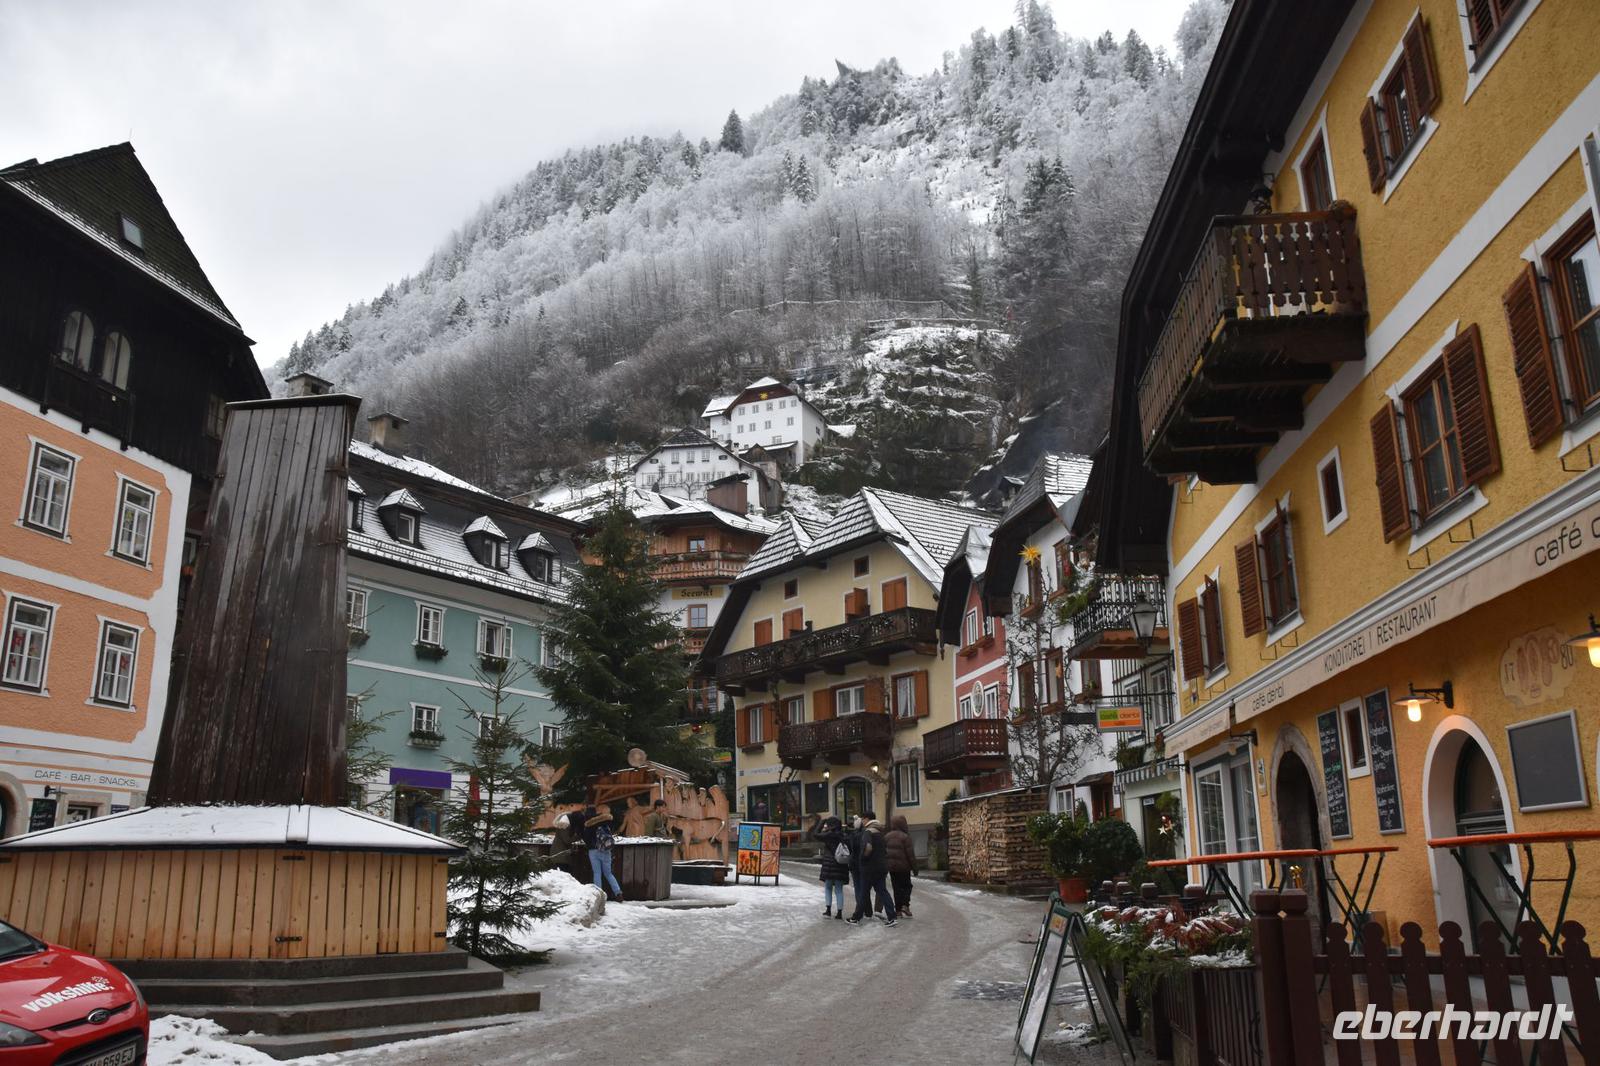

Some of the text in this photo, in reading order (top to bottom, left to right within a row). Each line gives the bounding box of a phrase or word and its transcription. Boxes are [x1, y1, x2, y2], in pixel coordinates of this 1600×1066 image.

[1535, 521, 1582, 566] café
[1323, 596, 1437, 673] KONDITOREI RESTAURANT
[70, 773, 91, 783] BAR
[99, 775, 136, 787] SNACKS
